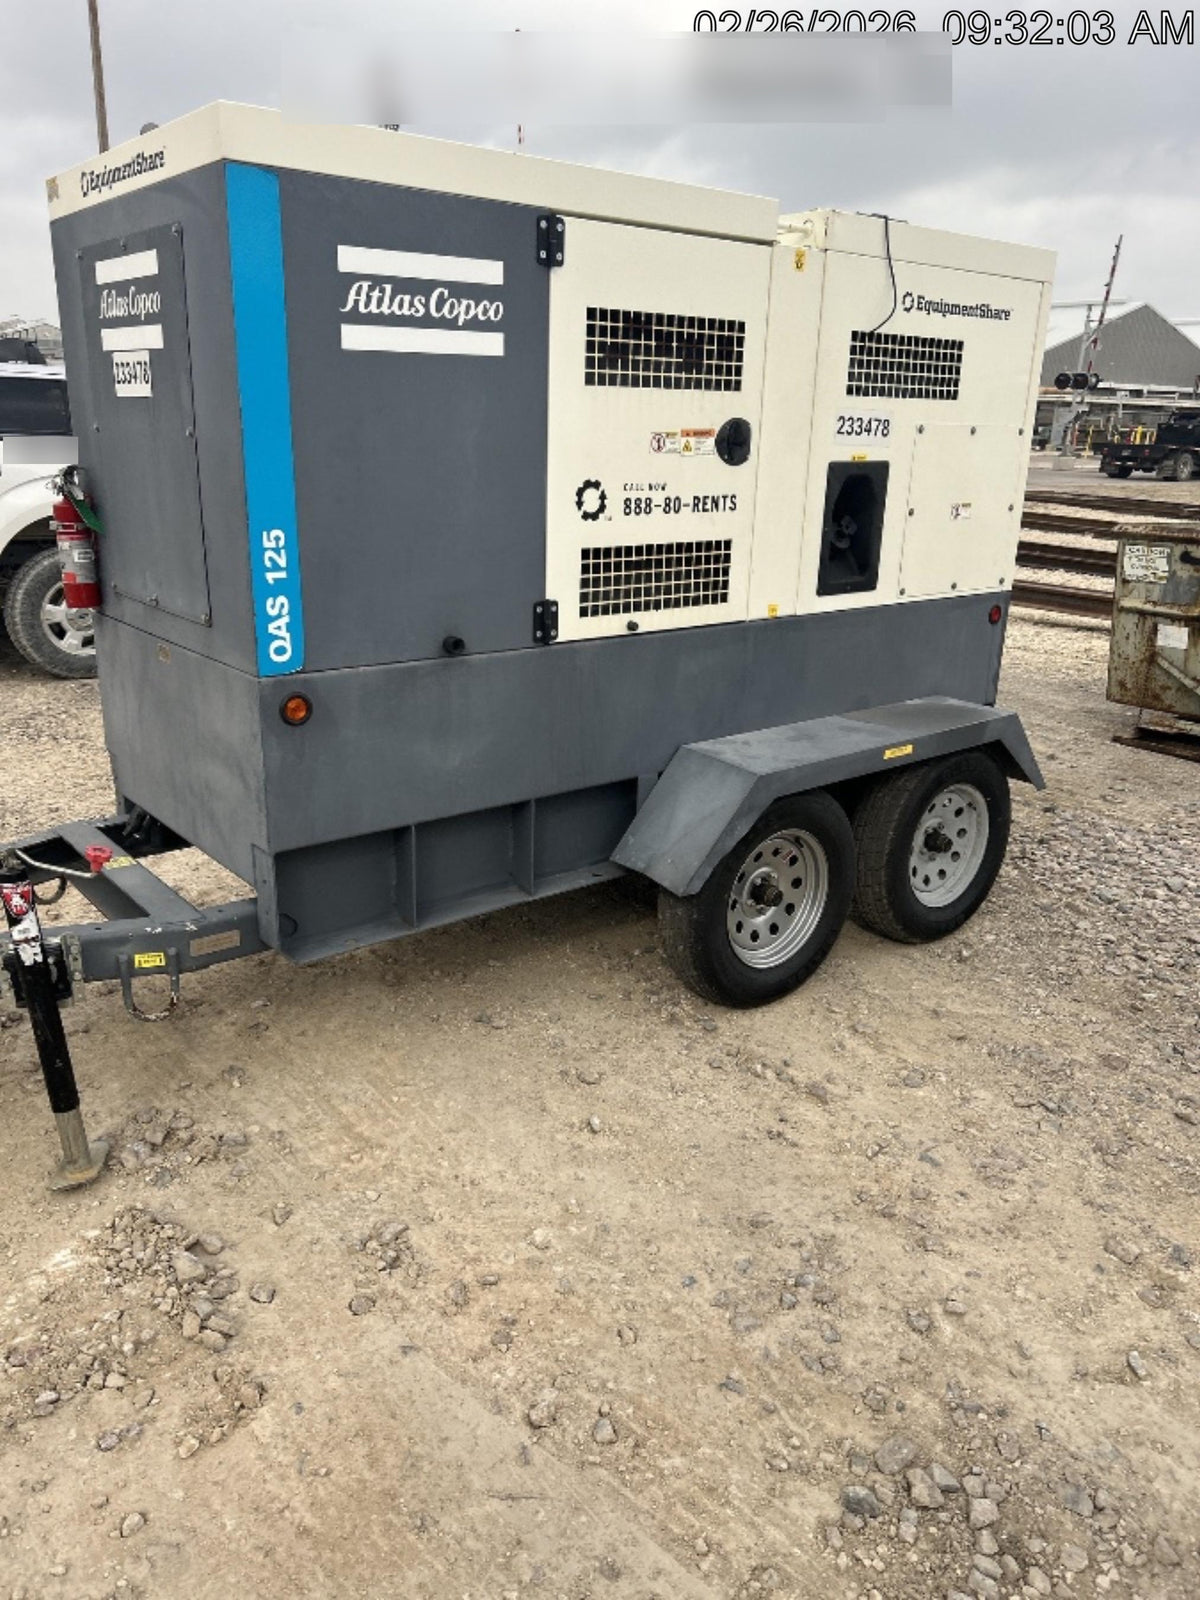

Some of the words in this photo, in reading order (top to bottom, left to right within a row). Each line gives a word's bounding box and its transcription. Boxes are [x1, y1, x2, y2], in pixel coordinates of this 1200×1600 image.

[90, 150, 165, 194] EquipmentShare
[99, 286, 129, 319] Atlas
[128, 286, 161, 321] Copco
[339, 280, 426, 318] Atlas
[429, 287, 504, 327] Copco
[916, 295, 1011, 321] EquipmentShare
[114, 360, 150, 385] 233478
[836, 415, 890, 438] 233478
[623, 482, 645, 492] CALL
[648, 482, 667, 492] NOW
[623, 494, 737, 516] 888-80-RENTS
[262, 528, 287, 586] 125
[266, 594, 292, 663] QAS
